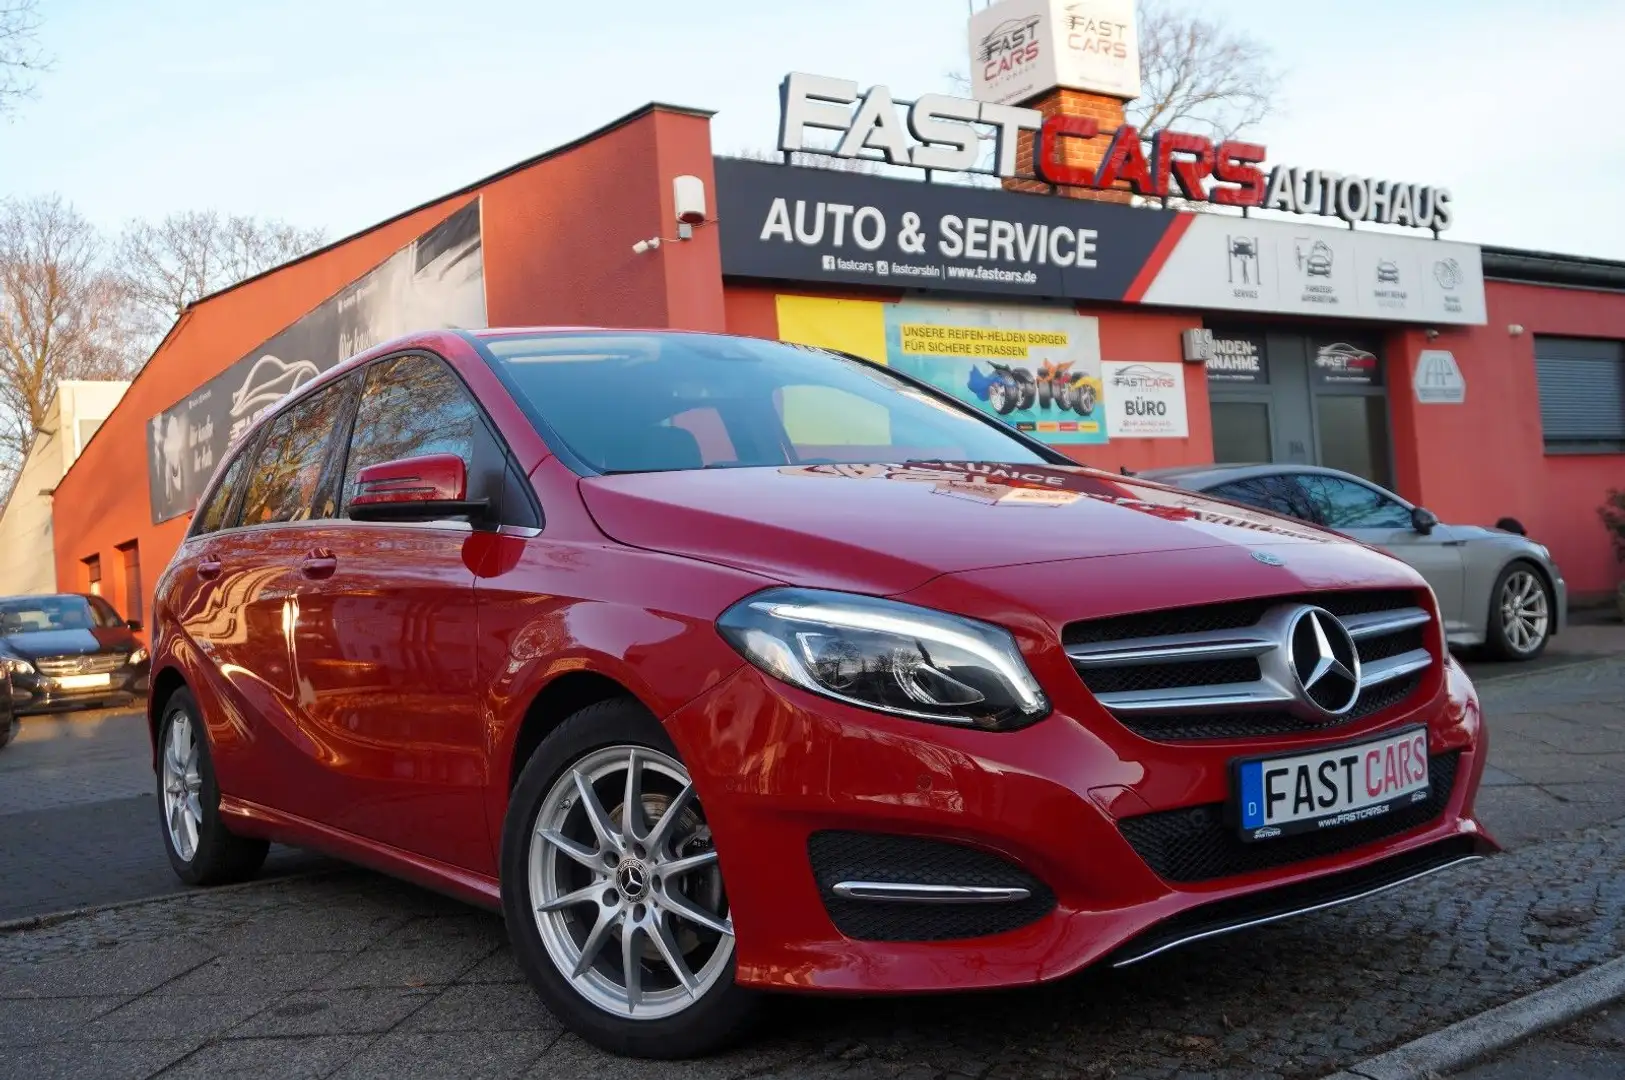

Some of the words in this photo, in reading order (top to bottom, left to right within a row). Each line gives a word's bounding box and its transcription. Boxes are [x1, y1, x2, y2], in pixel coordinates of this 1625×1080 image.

[1067, 15, 1127, 38] FAST
[983, 20, 1039, 60] FAST
[1068, 33, 1127, 59] CARS
[985, 40, 1038, 81] CARS
[1267, 164, 1453, 231] AUTOHAUS
[760, 197, 887, 250] AUTO
[898, 211, 927, 253] &
[938, 214, 1098, 268] SERVICE
[837, 258, 874, 272] fastcars
[948, 265, 1038, 284] www.fastcars.de
[903, 326, 945, 338] UNSERE
[948, 328, 1026, 343] REIFEN-HELDEN
[1028, 333, 1067, 345] SORGEN
[904, 339, 925, 351] FÜR
[928, 342, 972, 354] SICHERE
[1125, 396, 1167, 416] BÜRO
[1248, 801, 1257, 817] D
